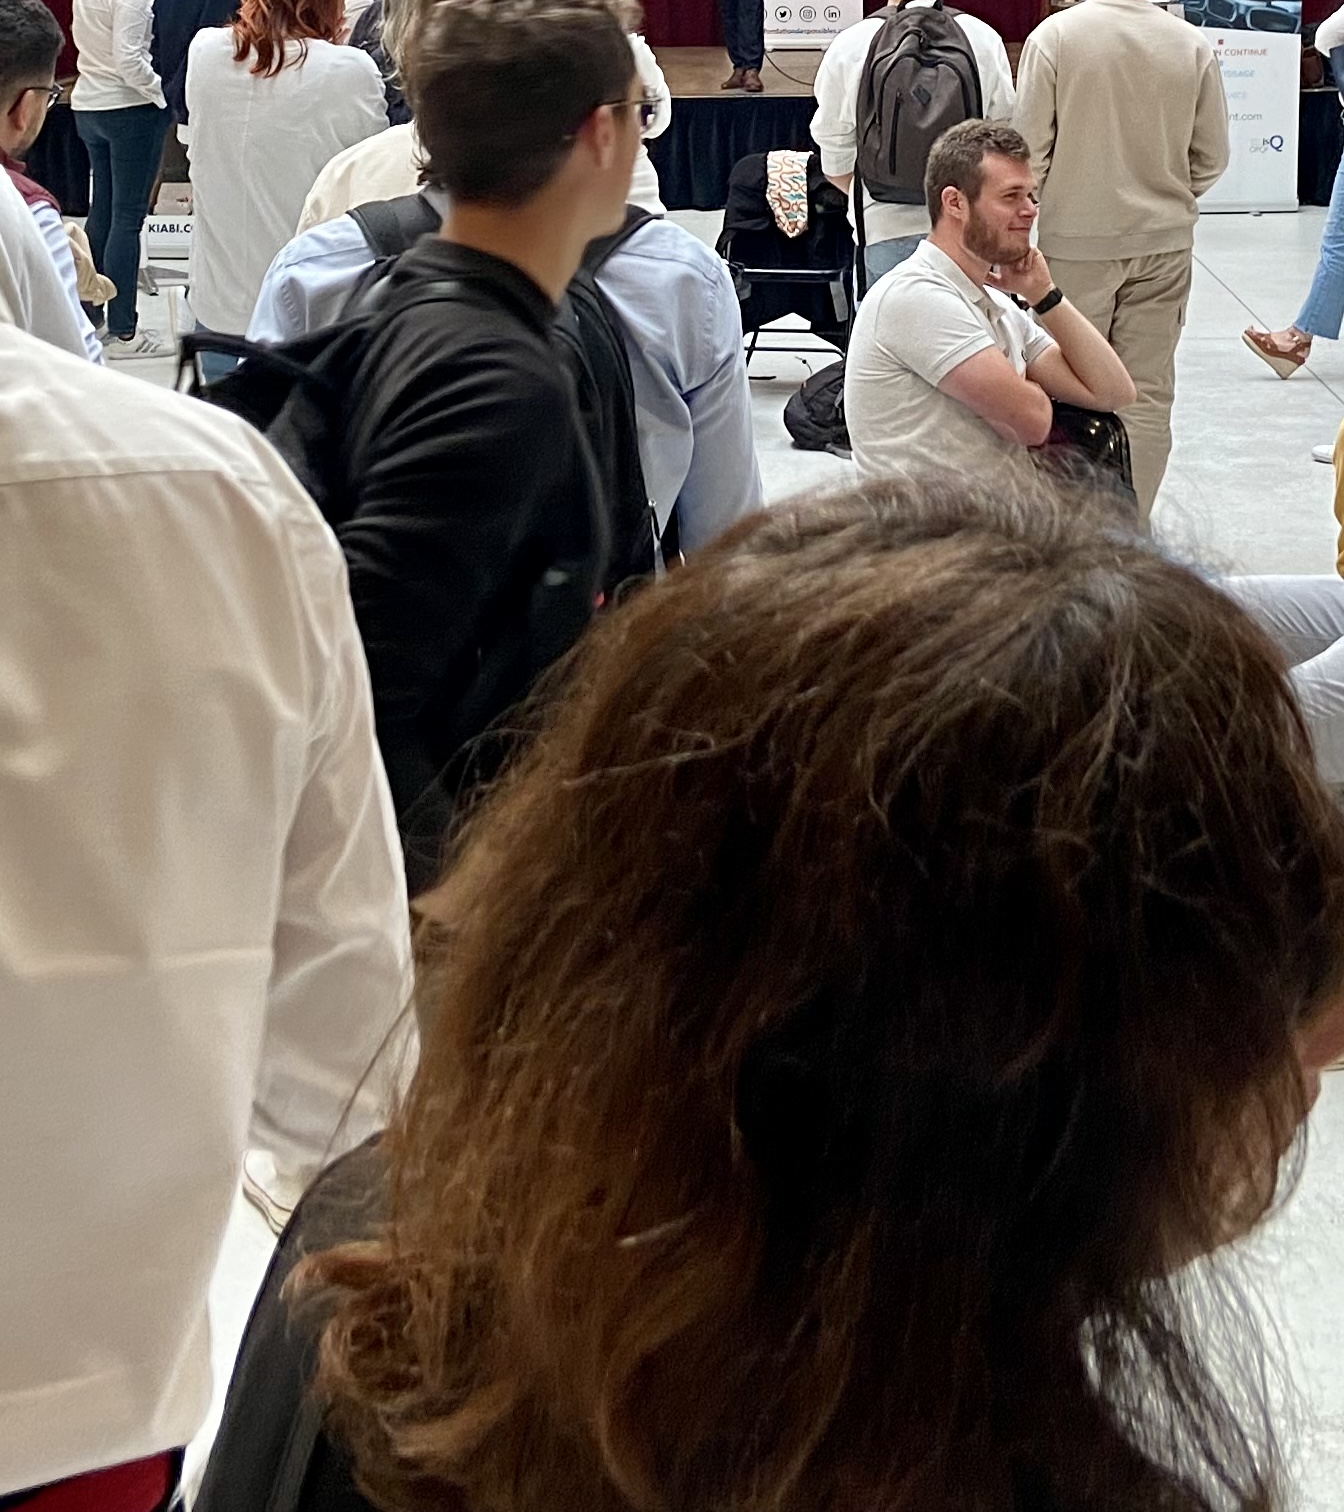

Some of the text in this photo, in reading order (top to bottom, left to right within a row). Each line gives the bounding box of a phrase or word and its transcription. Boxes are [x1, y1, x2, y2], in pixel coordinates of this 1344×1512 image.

[1224, 49, 1268, 57] CONTINUE
[1229, 113, 1263, 121] nt.com
[148, 224, 193, 234] KIABI.C
